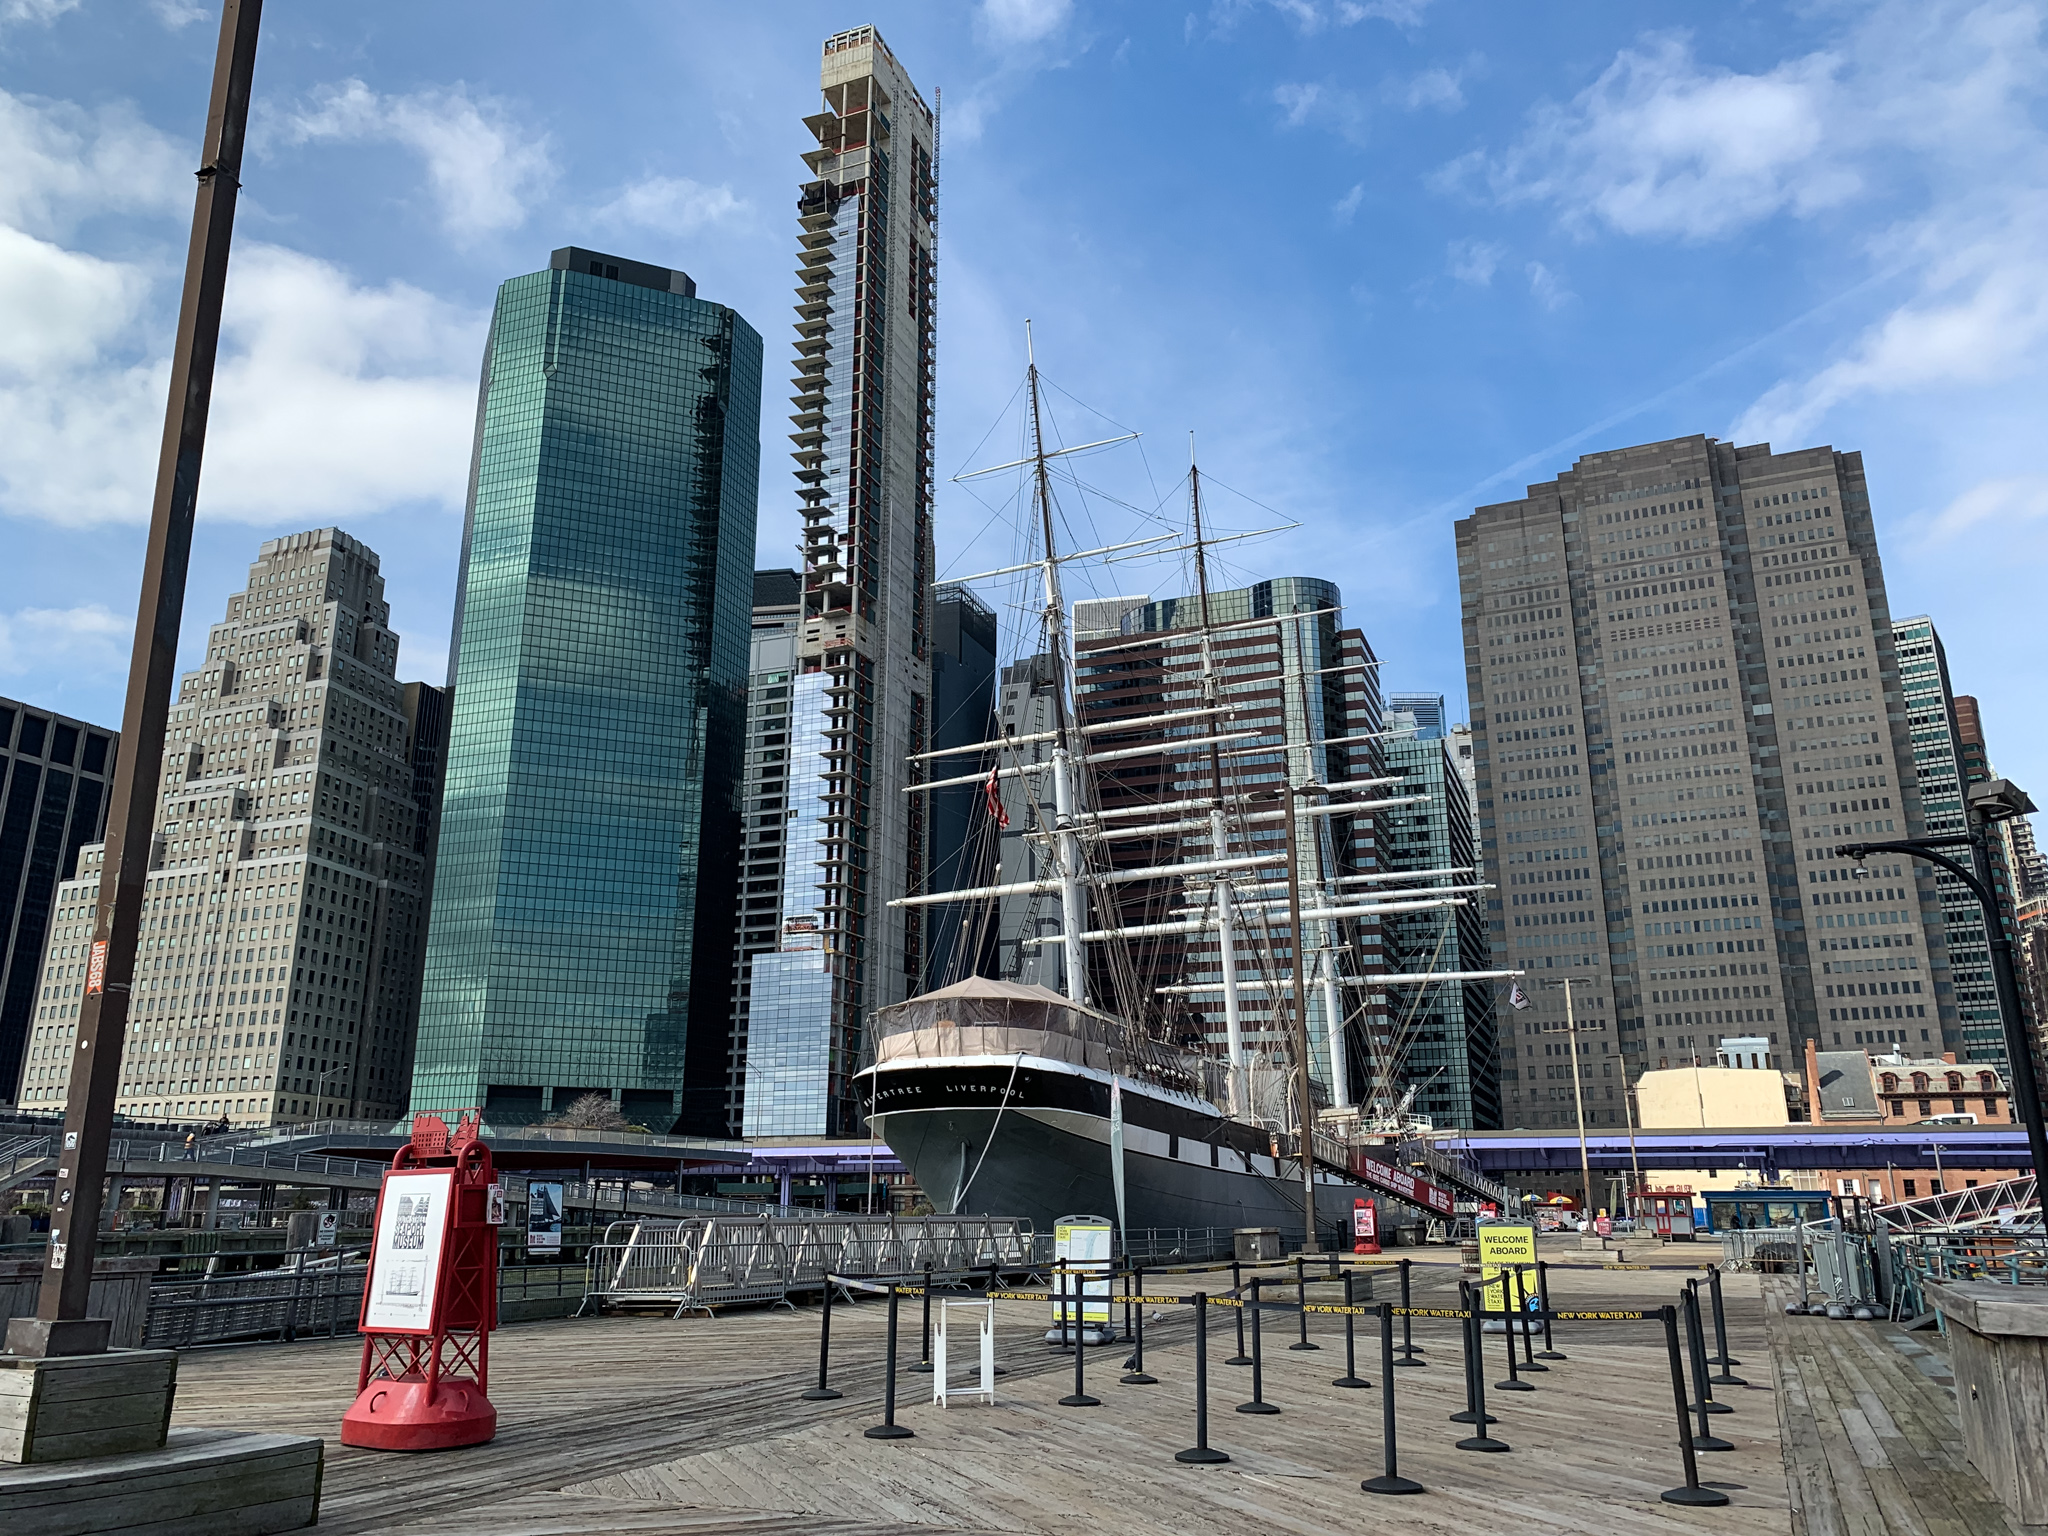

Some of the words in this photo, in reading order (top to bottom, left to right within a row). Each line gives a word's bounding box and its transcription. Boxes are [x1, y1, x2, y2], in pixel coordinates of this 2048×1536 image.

[89, 942, 105, 987] JABS68
[863, 1086, 922, 1107] WAERTREE
[946, 1085, 1024, 1099] LIVERPOOL
[1366, 1158, 1391, 1180] WELCOME
[1393, 1170, 1414, 1189] ABOARD
[395, 1222, 426, 1236] SEAPORT
[392, 1235, 425, 1249] MUSEUM
[1484, 1236, 1529, 1244] WELCOME
[1490, 1247, 1527, 1255] ABOARD
[912, 1287, 925, 1295] TAXI
[1215, 1298, 1231, 1306] WATER
[1231, 1299, 1244, 1307] TAXI
[1317, 1305, 1333, 1313] YORK
[1333, 1306, 1352, 1314] WATER
[1352, 1307, 1365, 1315] TAXI
[1391, 1308, 1408, 1316] NEW
[1408, 1308, 1429, 1317] YORK
[1429, 1309, 1455, 1318] WATER
[1454, 1310, 1472, 1318] TAXI
[1557, 1312, 1576, 1320] NEW
[1576, 1312, 1598, 1320] YORK
[1598, 1312, 1626, 1320] WATER
[1625, 1312, 1642, 1320] TAXI
